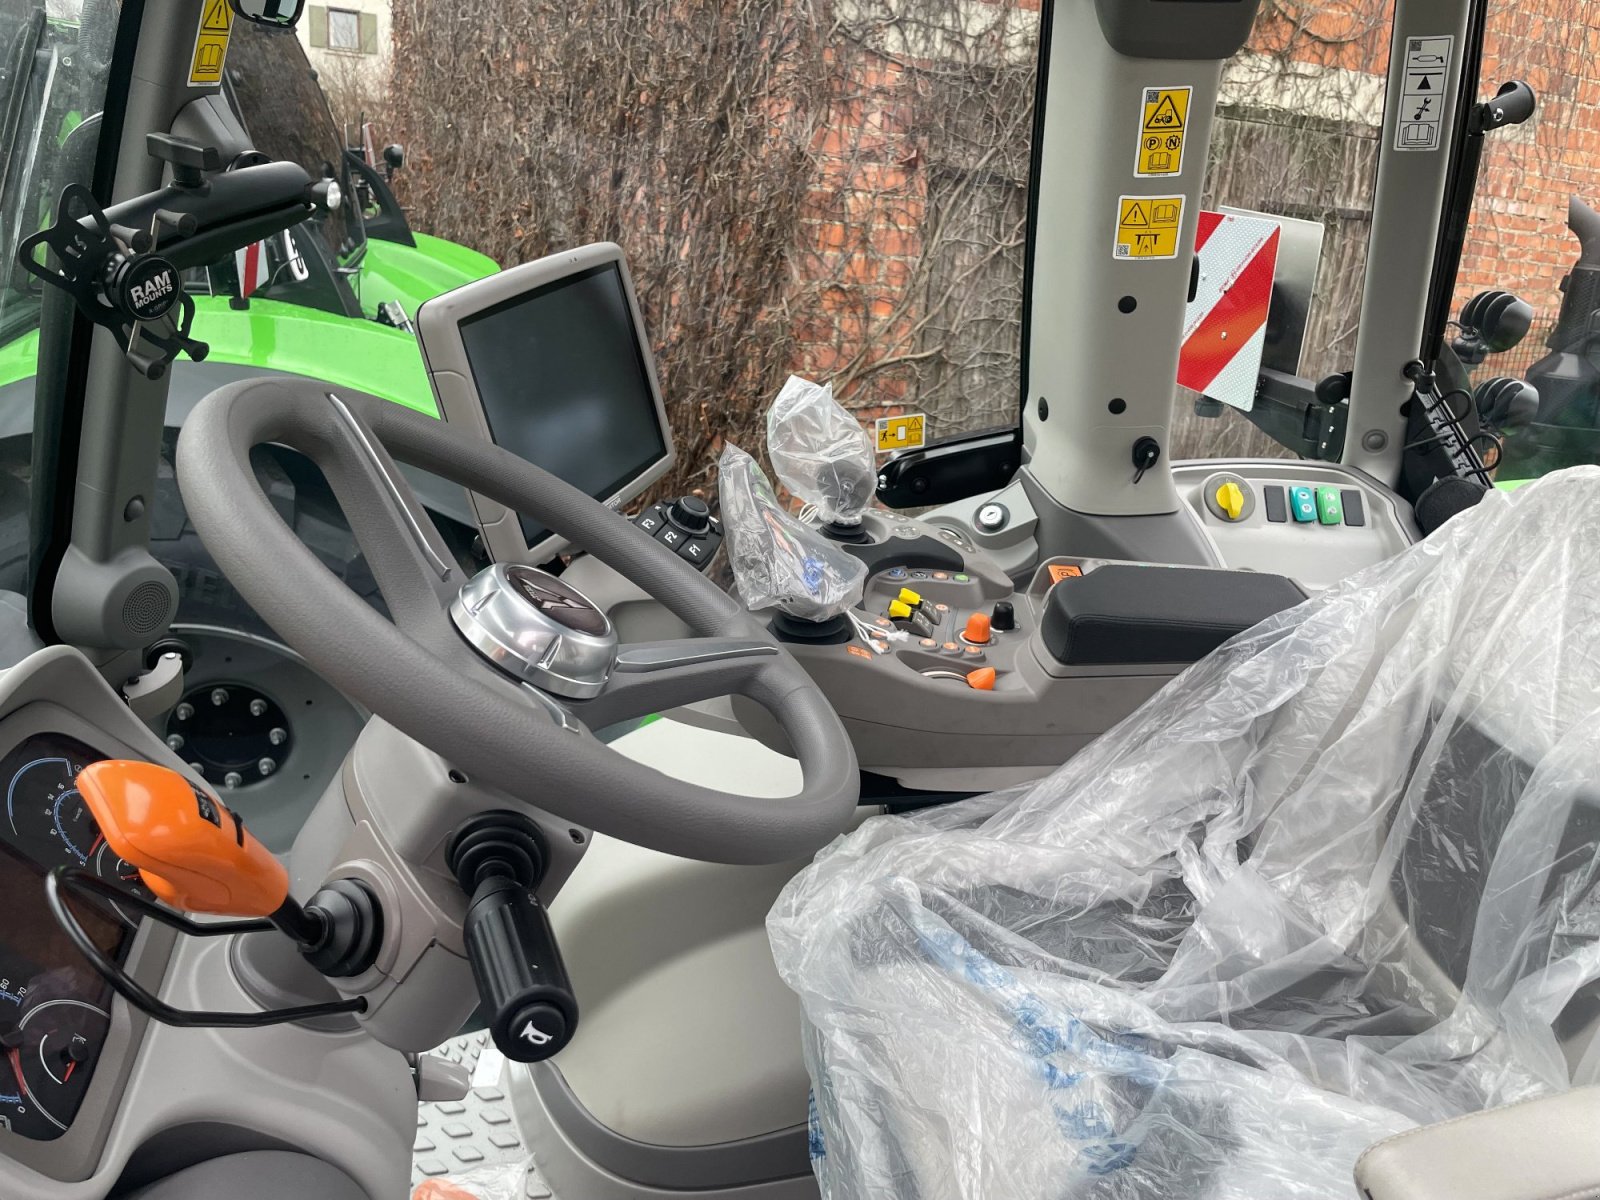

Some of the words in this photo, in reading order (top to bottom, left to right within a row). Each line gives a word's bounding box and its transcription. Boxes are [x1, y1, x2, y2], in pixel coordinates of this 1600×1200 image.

[130, 271, 171, 303] RAM
[135, 284, 173, 309] MOUNTS
[641, 518, 655, 530] F3
[664, 531, 678, 544] F2
[688, 543, 701, 557] F1
[0, 978, 10, 990] 60
[17, 986, 27, 998] 70
[17, 1105, 26, 1114] 0
